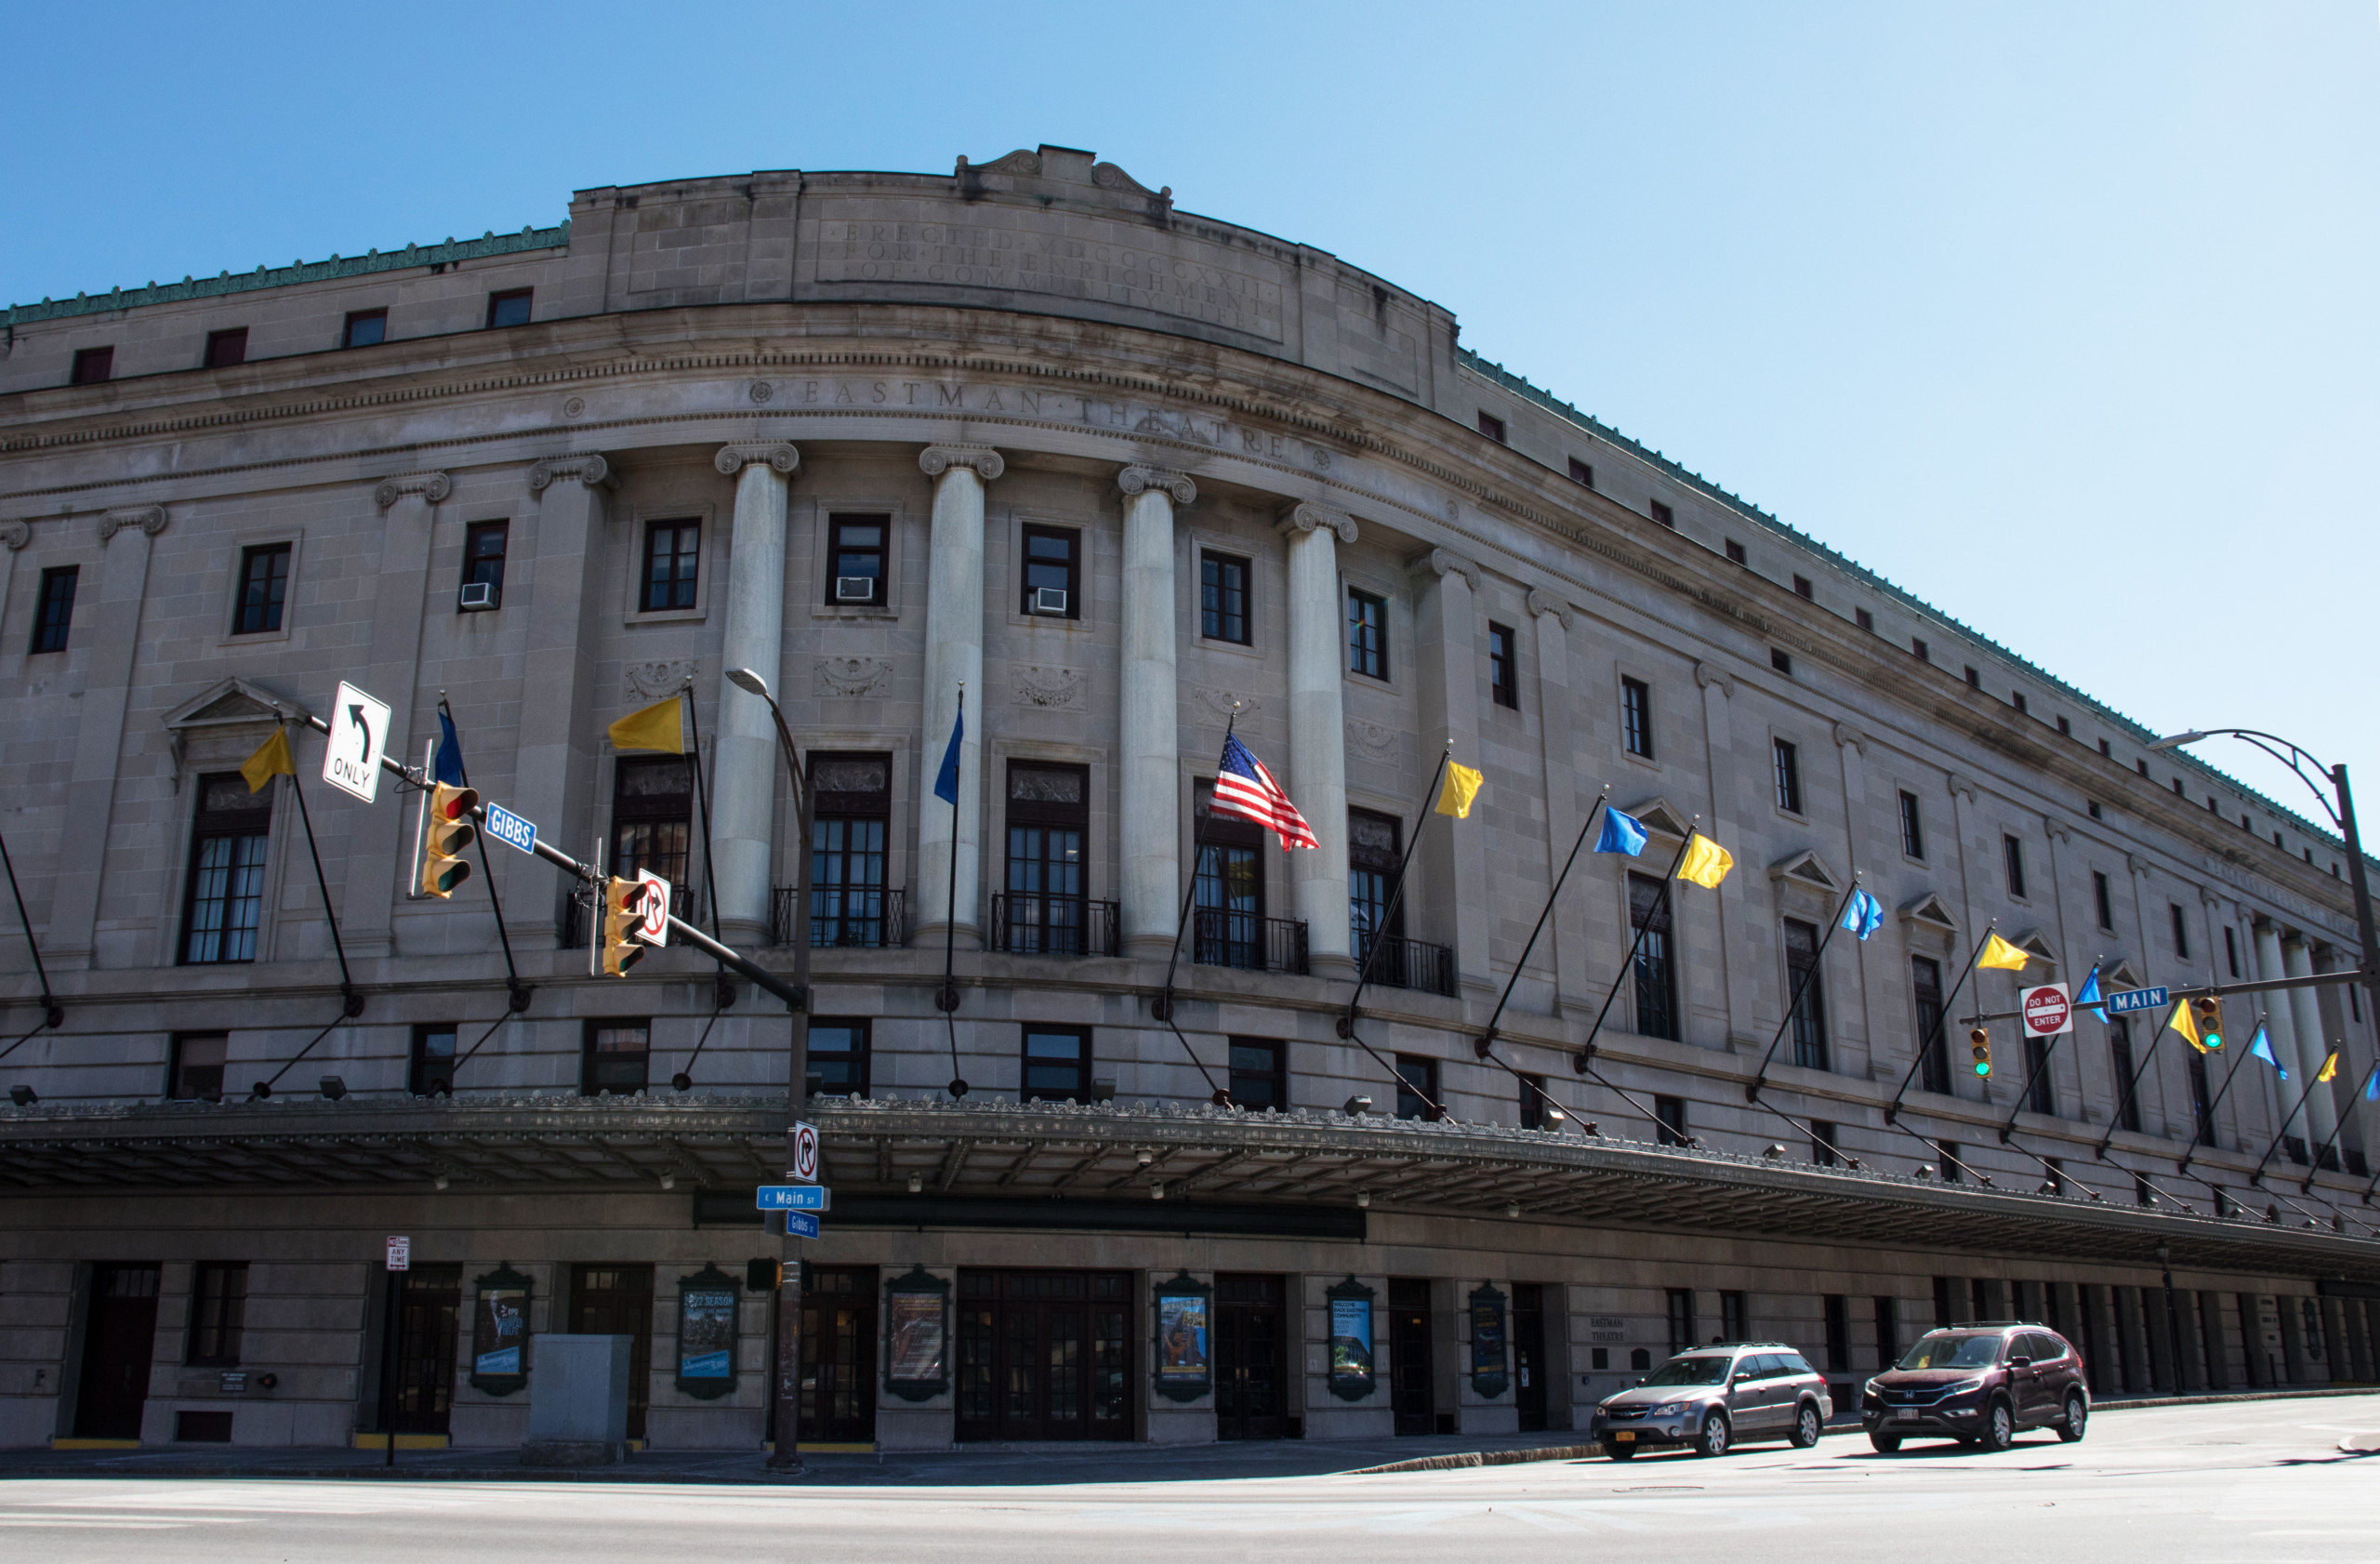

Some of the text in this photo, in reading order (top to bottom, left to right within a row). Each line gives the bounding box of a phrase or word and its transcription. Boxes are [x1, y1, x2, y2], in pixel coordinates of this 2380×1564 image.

[847, 224, 1260, 298] ERECTED MDCCCCXXII
[842, 242, 1263, 315] FOR THE ENRICHMENT
[862, 261, 1245, 325] OF COMMUNITY LIFE
[801, 380, 1283, 458] EASTMAN THEATRE
[334, 757, 370, 789] ONLY
[491, 809, 531, 847] GIBBS
[2030, 994, 2061, 1007] DO NOT
[2116, 988, 2162, 1010] MAIN
[2034, 1014, 2061, 1027] ENTER
[776, 1191, 803, 1205] Main
[791, 1215, 809, 1232] Gibbs
[705, 1295, 734, 1306] SEASON
[1591, 1317, 1623, 1327] EASTMAN
[1592, 1332, 1624, 1342] THEATRE
